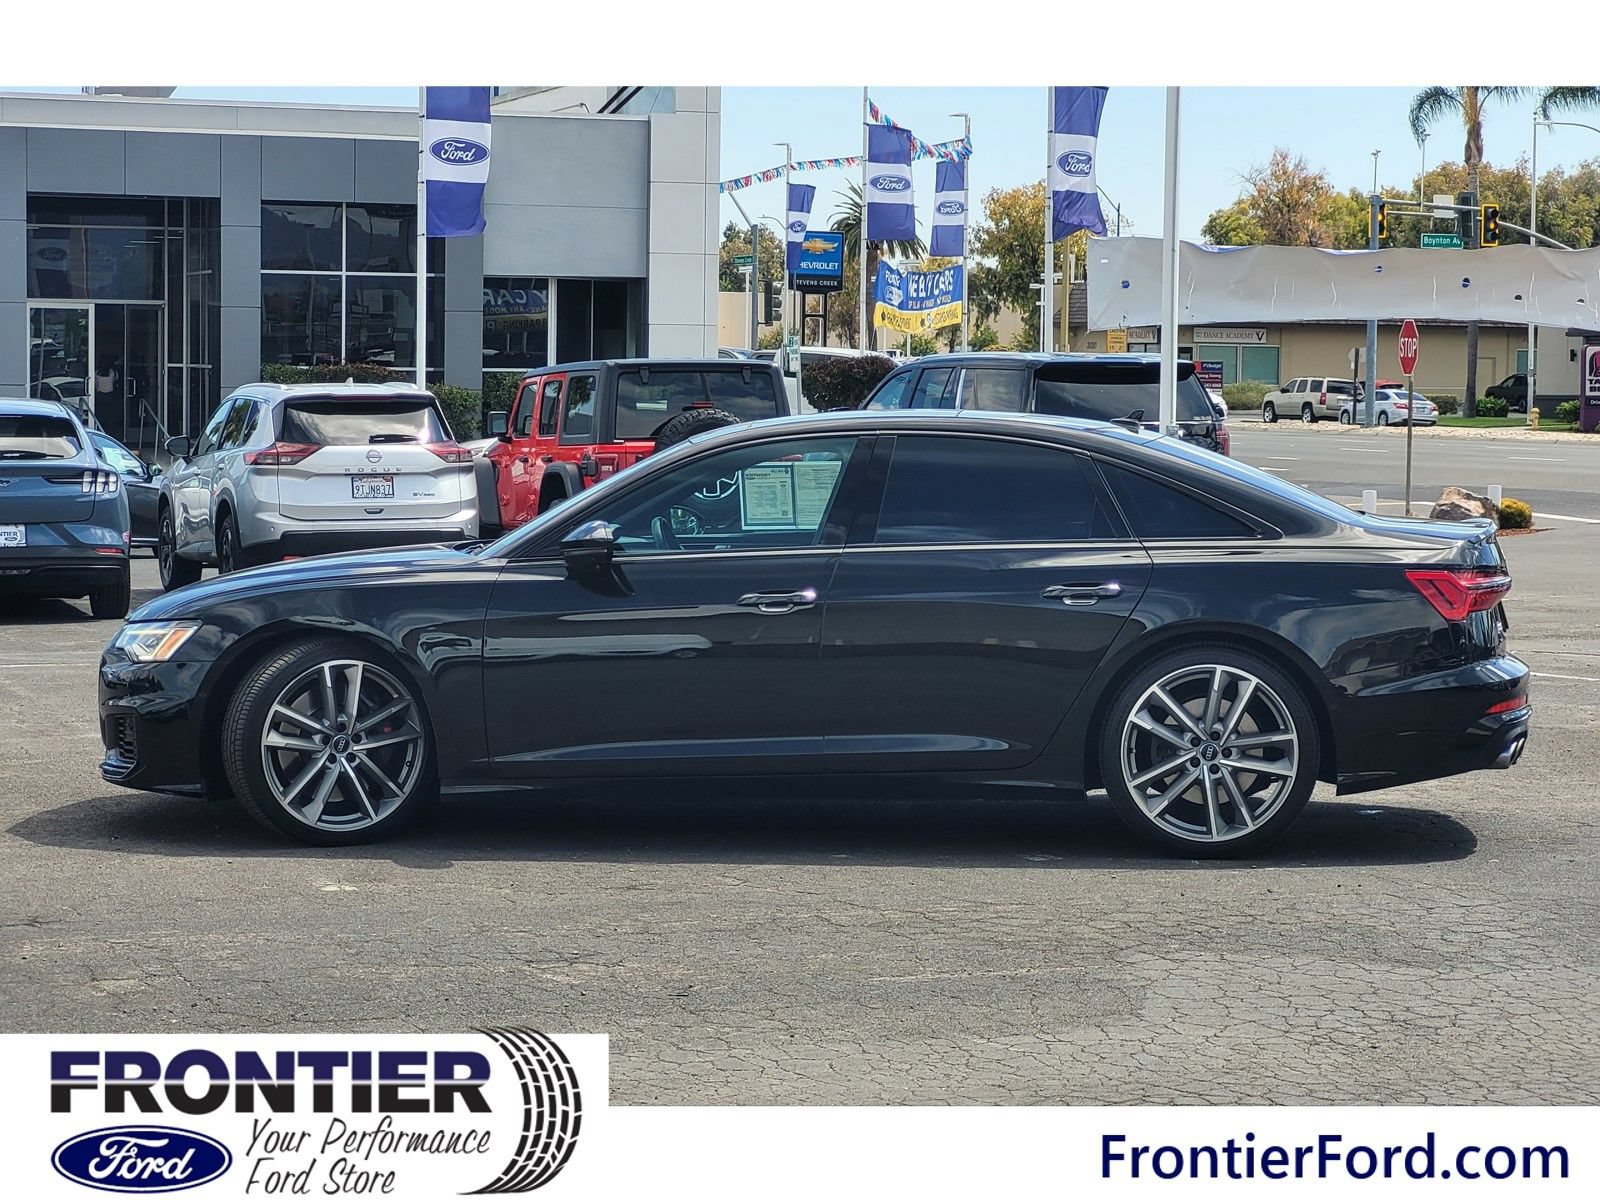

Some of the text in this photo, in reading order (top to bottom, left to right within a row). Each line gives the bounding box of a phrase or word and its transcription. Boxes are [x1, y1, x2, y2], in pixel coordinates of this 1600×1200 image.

[441, 141, 476, 161] Ford
[1065, 154, 1091, 173] Ford
[877, 177, 905, 189] Ford
[1424, 236, 1451, 246] Boynton
[800, 262, 839, 270] HEVROLET
[1400, 337, 1418, 358] STOP
[355, 484, 391, 496] 9TJN837
